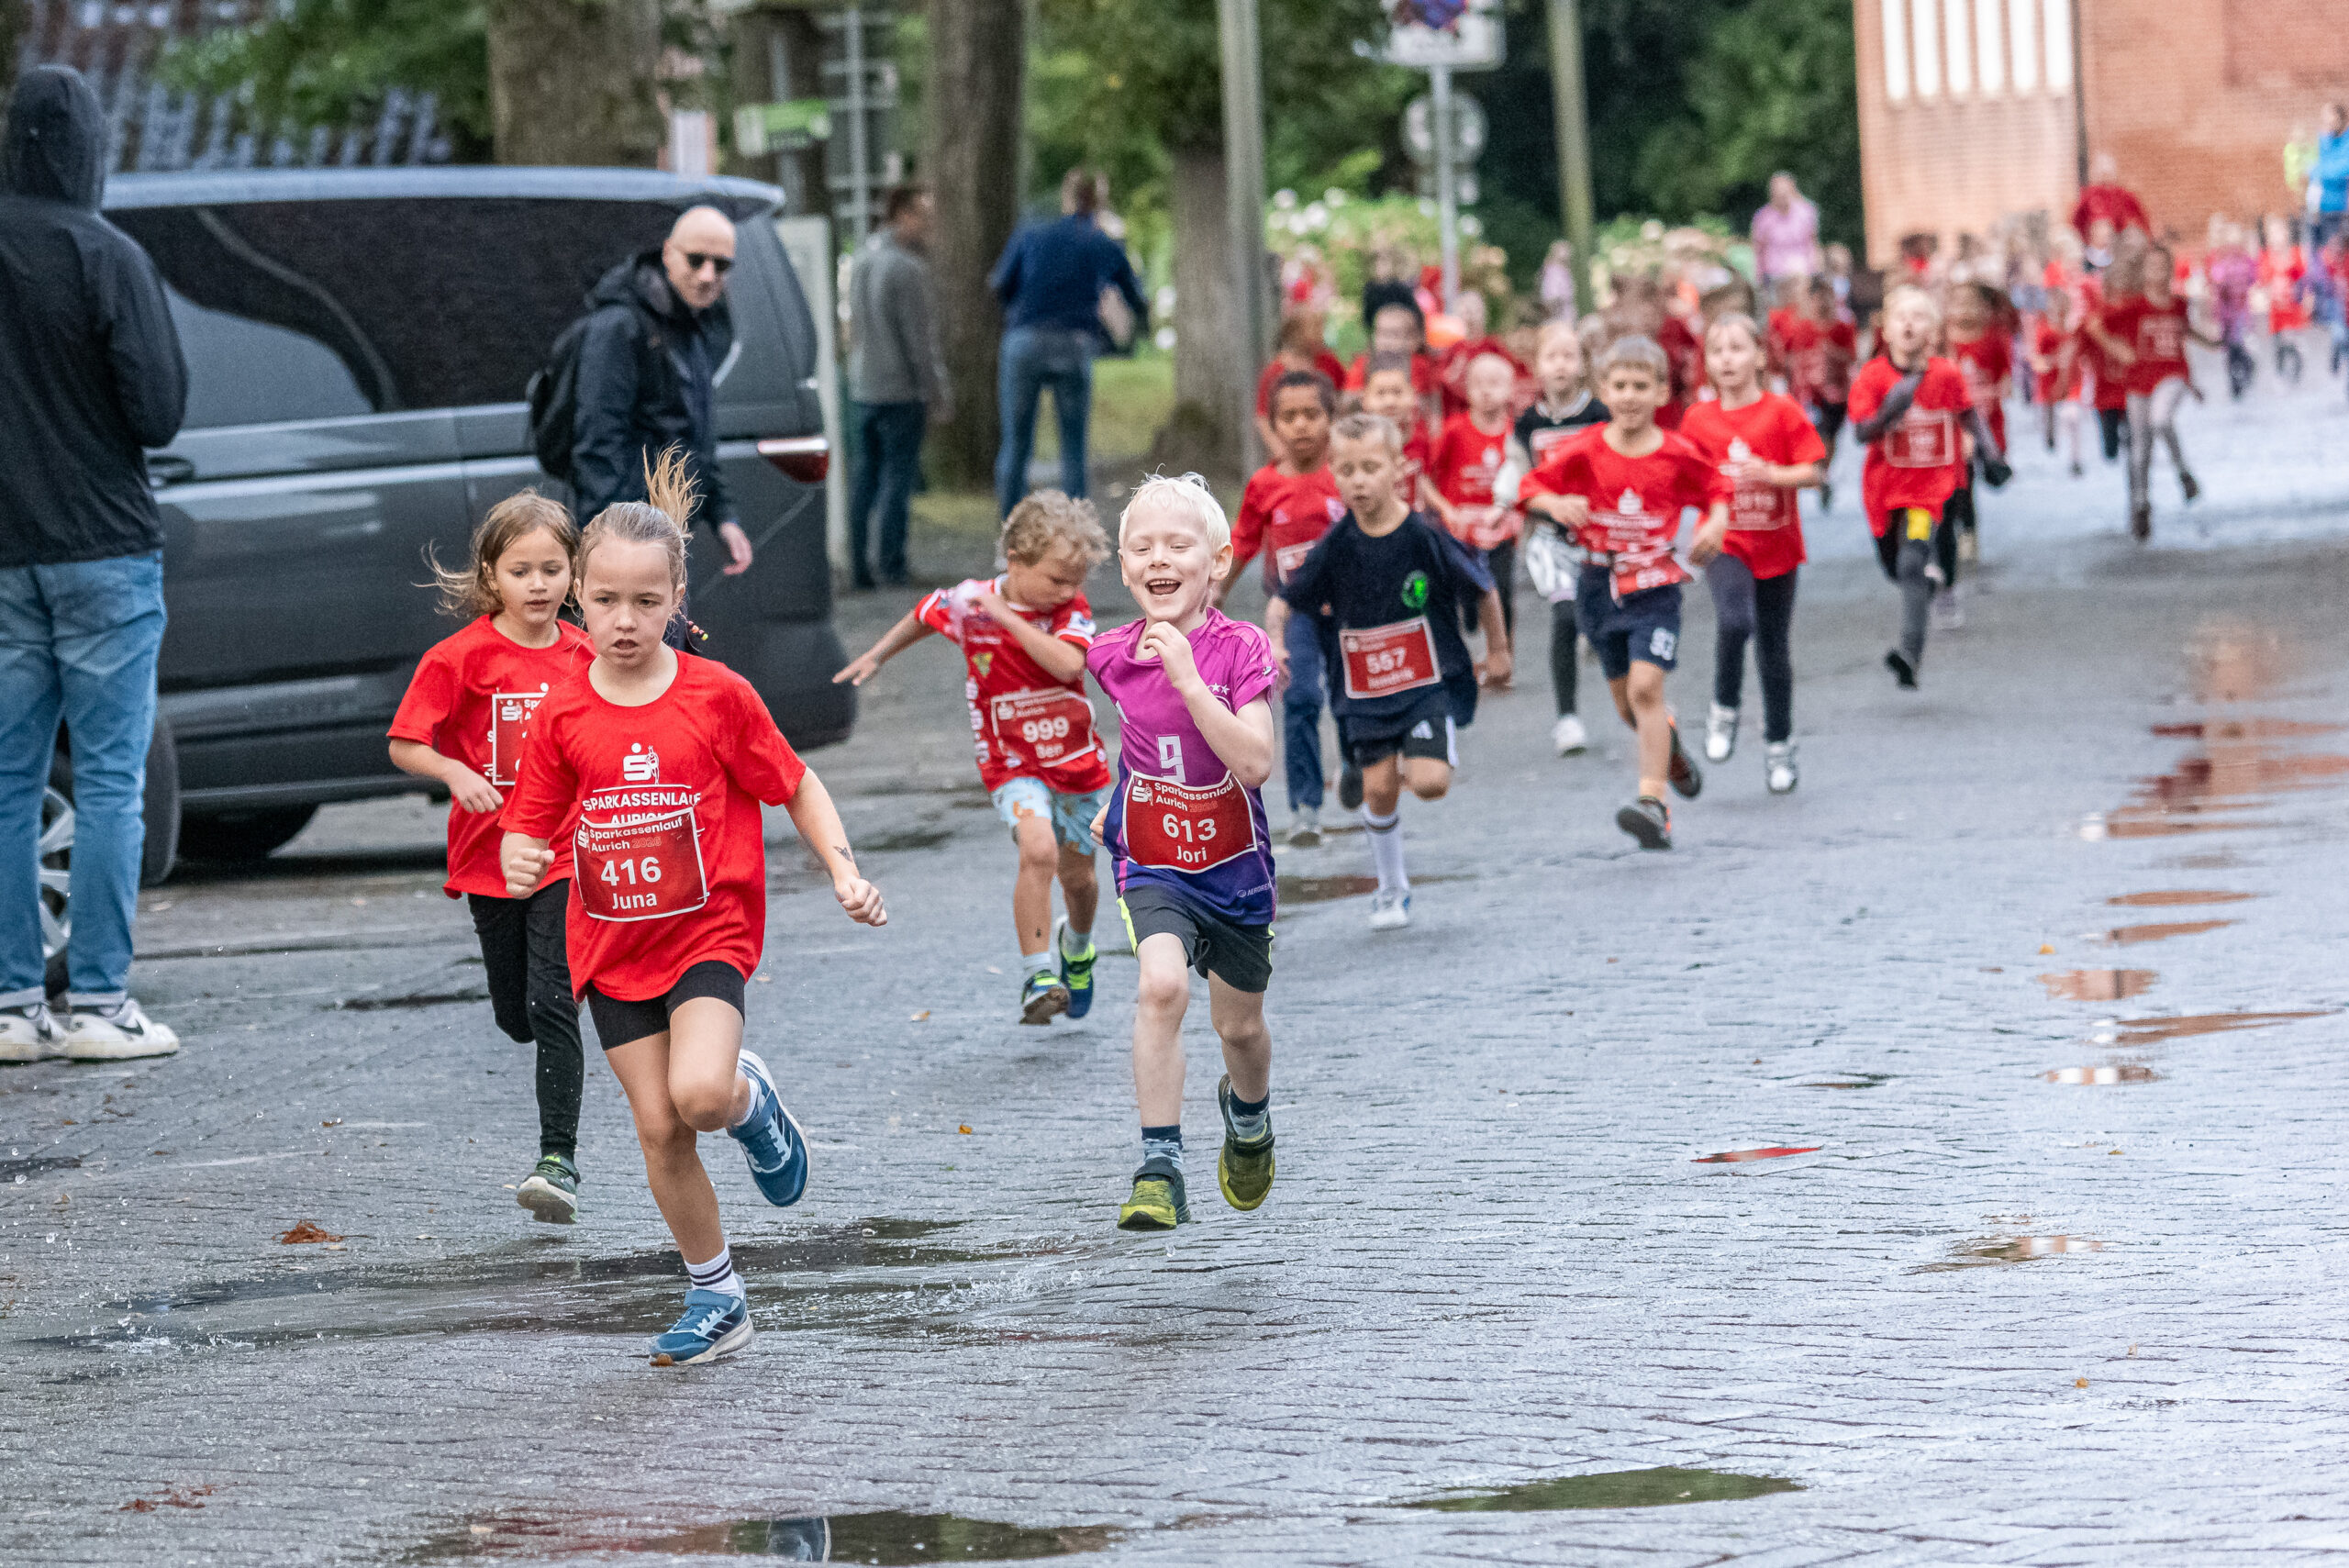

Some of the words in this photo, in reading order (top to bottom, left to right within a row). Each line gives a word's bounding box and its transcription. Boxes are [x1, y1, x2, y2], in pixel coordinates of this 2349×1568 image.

[1022, 716, 1070, 743] 999
[1155, 795, 1188, 812] Aurich
[589, 816, 683, 841] Sparkassenlauf
[1163, 813, 1217, 843] 613
[591, 840, 630, 852] Aurich
[1176, 845, 1208, 863] Jori
[600, 857, 662, 886] 416
[612, 892, 658, 910] Juna
